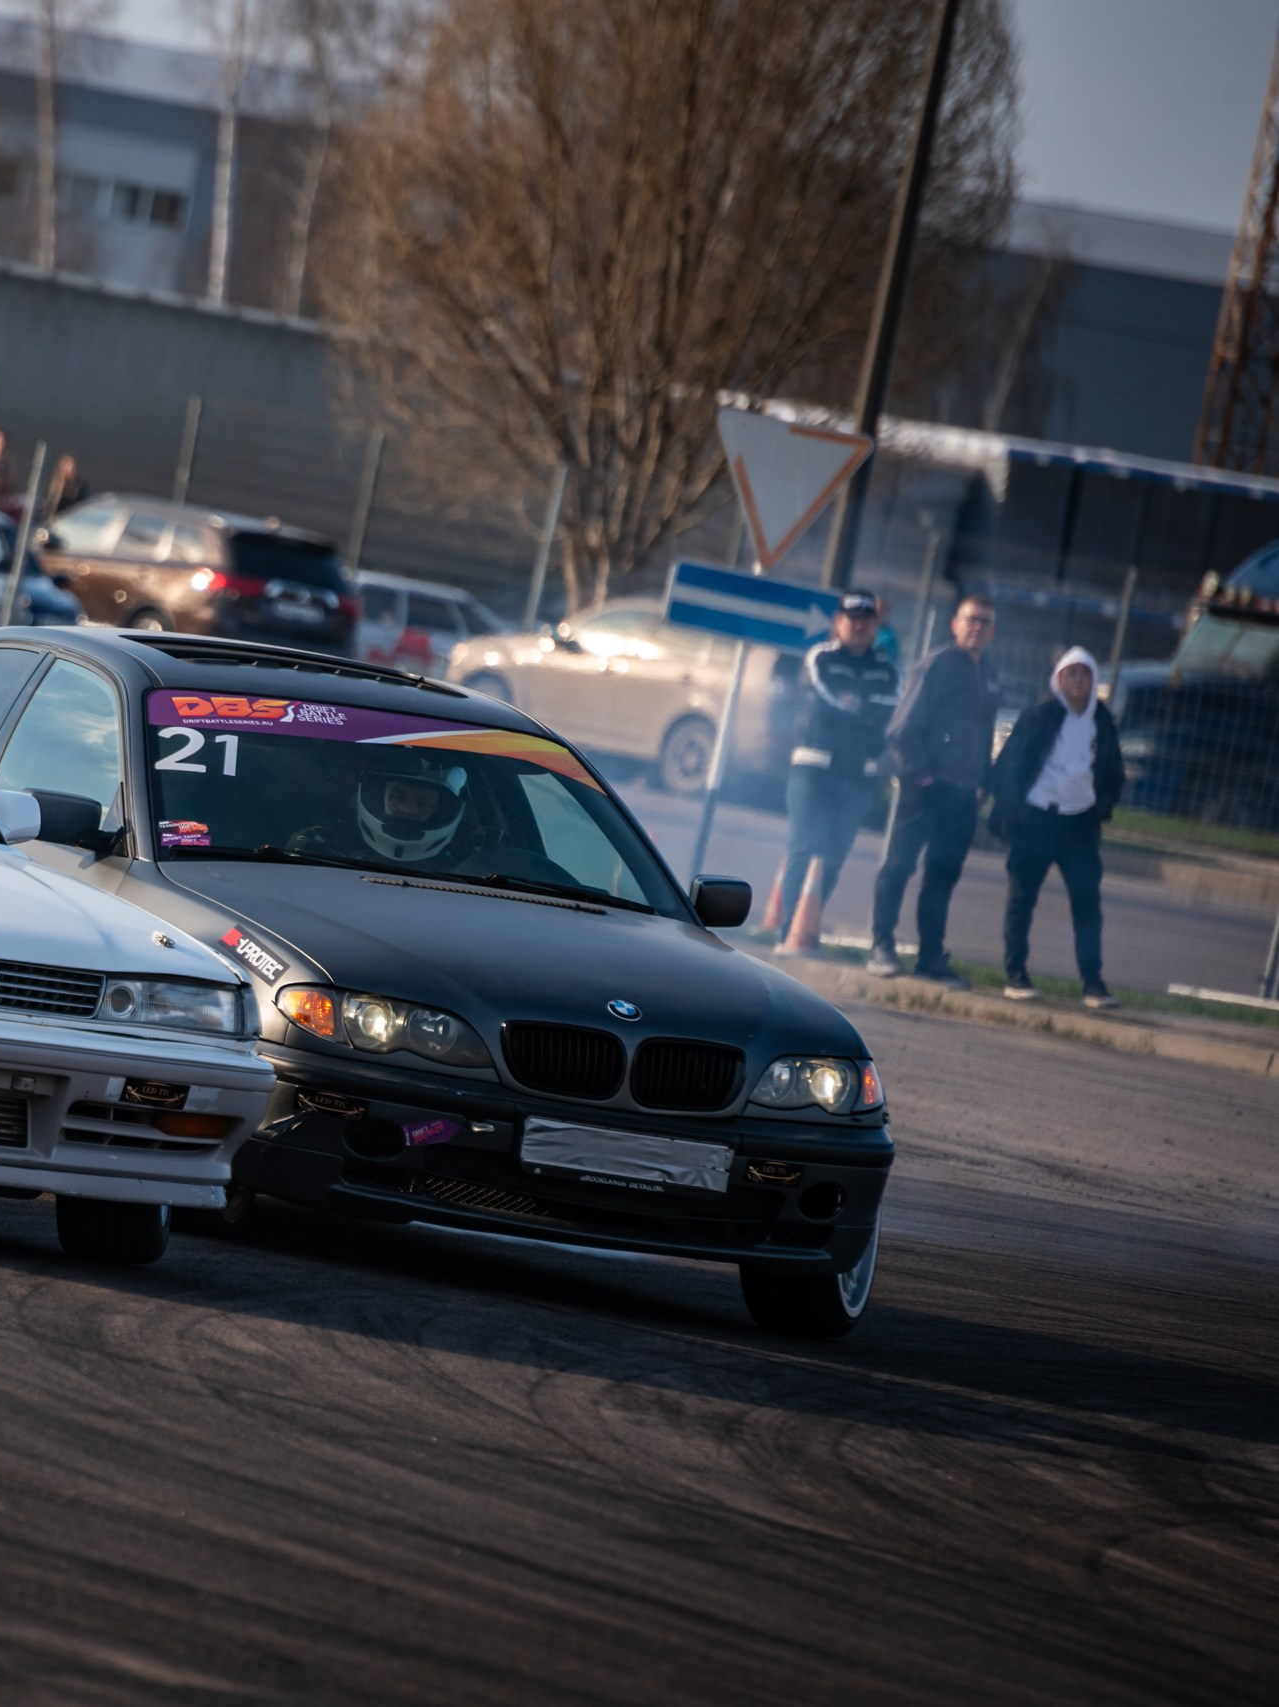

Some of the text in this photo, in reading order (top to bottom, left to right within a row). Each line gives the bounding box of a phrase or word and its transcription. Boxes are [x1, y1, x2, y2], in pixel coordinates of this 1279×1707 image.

[172, 696, 290, 718] DBS
[302, 703, 337, 714] DRIFT
[297, 713, 344, 726] SERIES
[299, 708, 348, 721] BATTLE
[182, 718, 274, 726] DRIFTBATTLESERIES.RU
[154, 726, 239, 777] 21
[142, 1085, 157, 1095] LED
